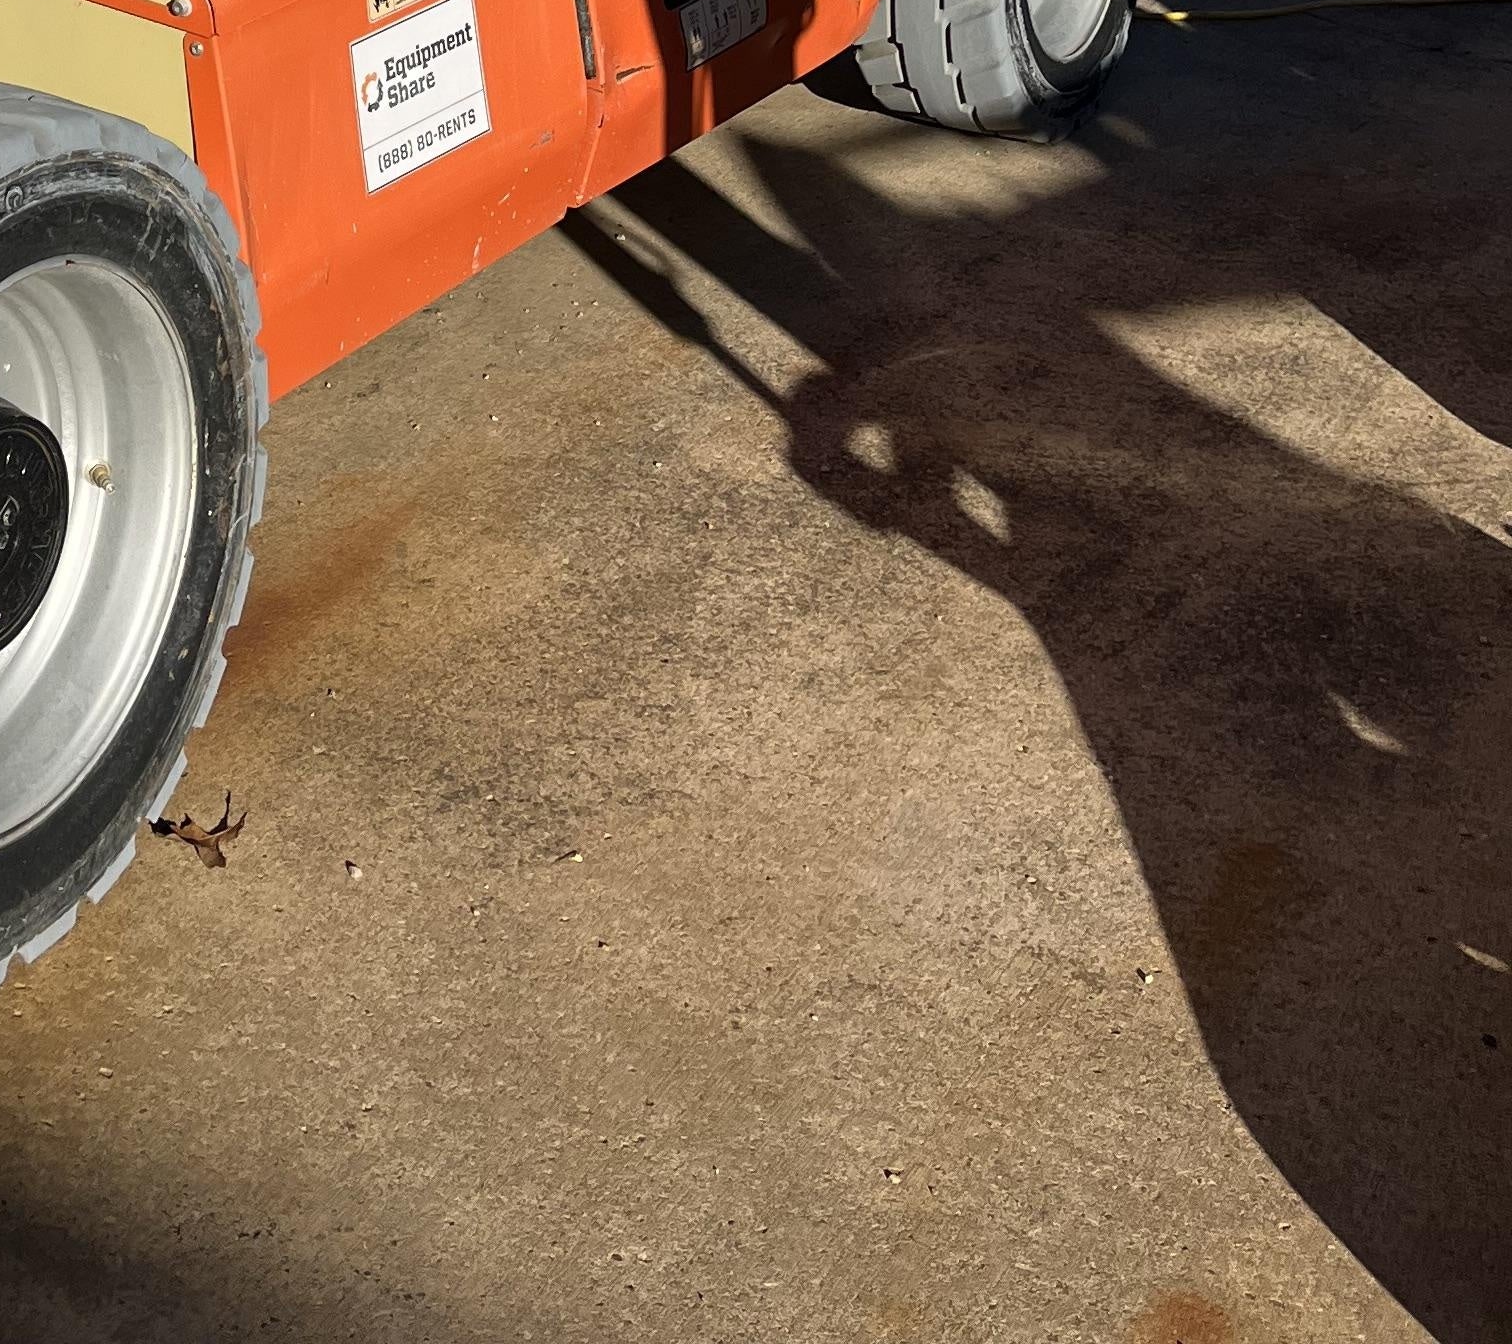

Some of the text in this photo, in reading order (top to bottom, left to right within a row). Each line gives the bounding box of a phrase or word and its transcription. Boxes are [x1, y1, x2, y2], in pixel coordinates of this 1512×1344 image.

[384, 22, 473, 82] Equipment
[388, 72, 437, 110] Share
[378, 108, 476, 173] (888) 80-RENTS
